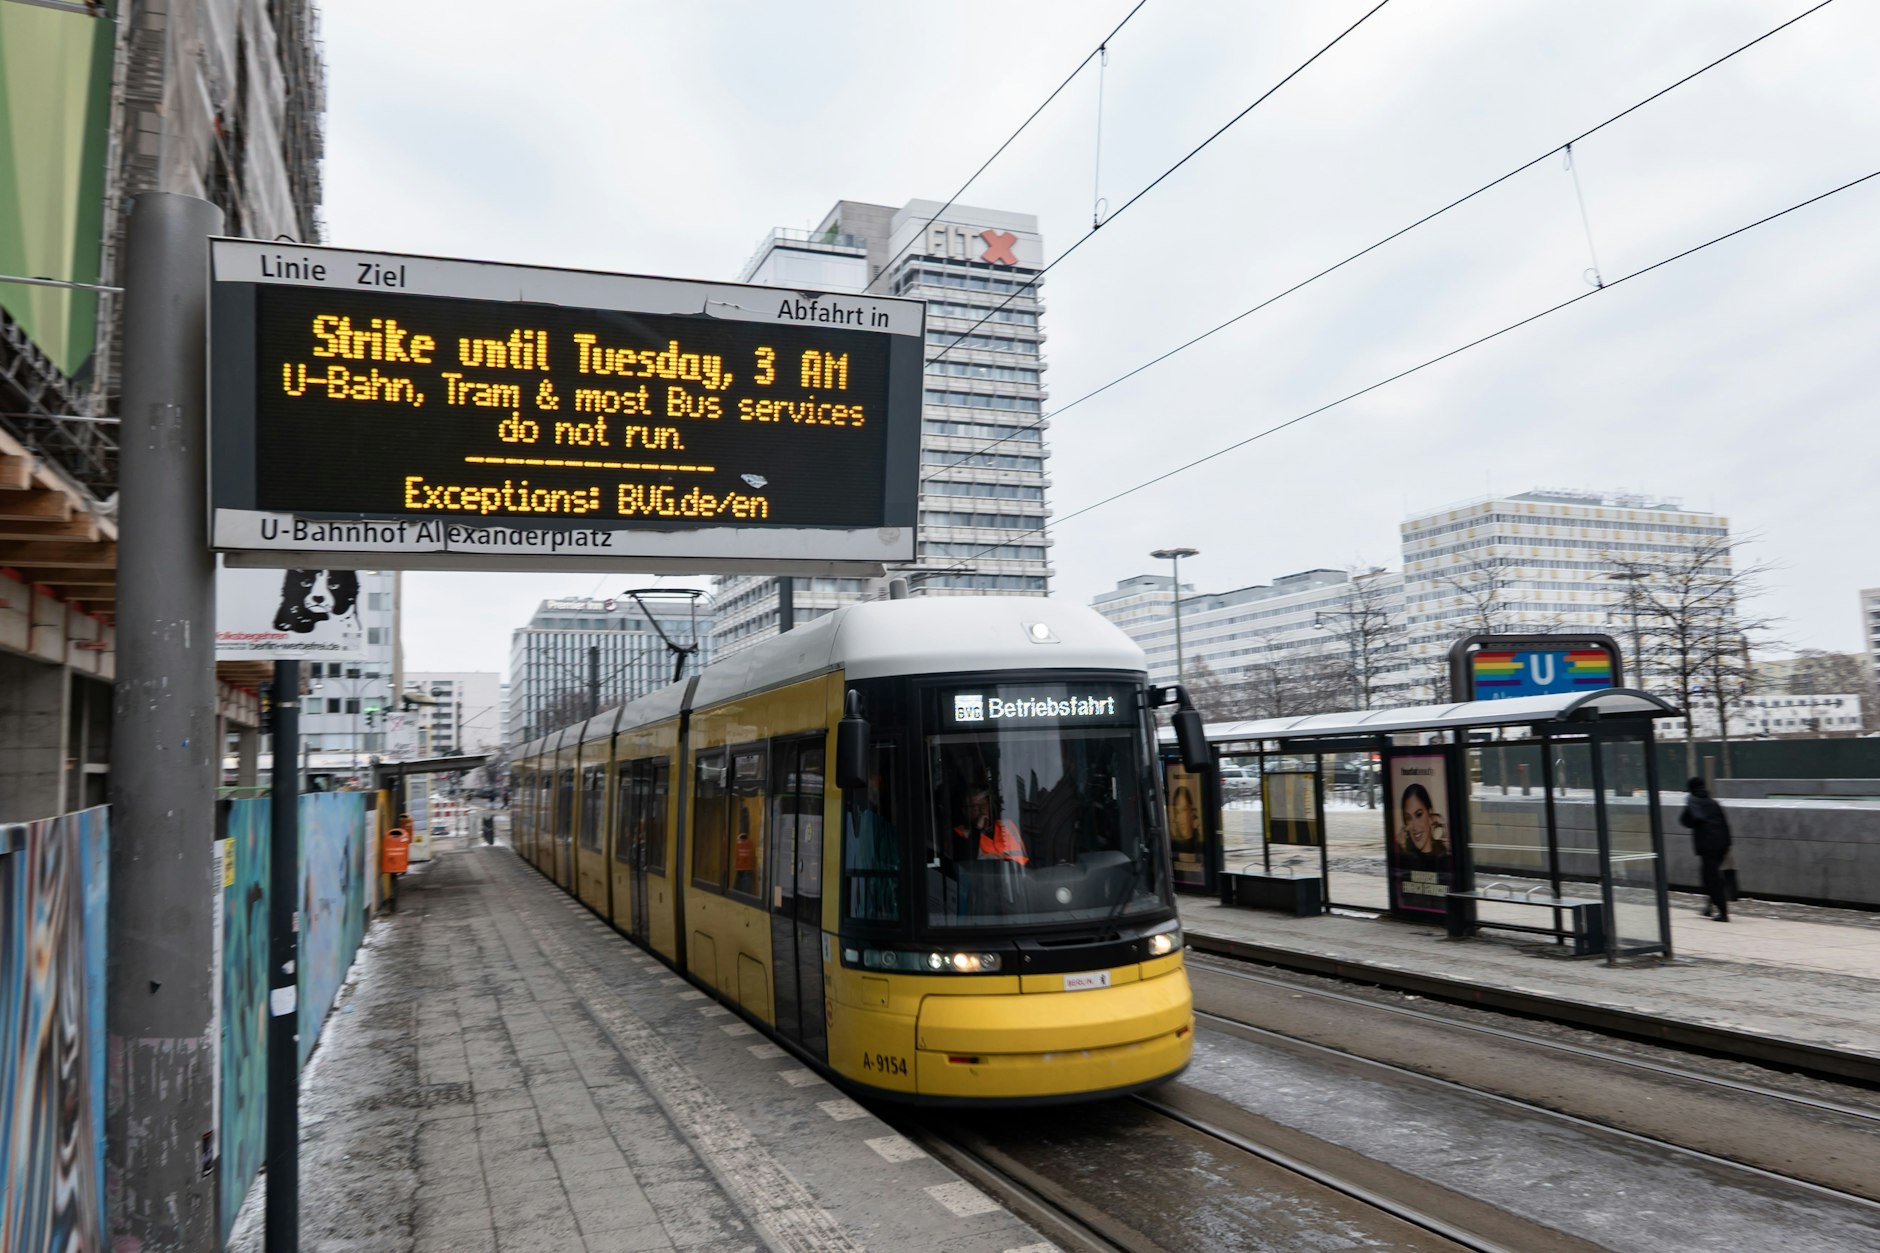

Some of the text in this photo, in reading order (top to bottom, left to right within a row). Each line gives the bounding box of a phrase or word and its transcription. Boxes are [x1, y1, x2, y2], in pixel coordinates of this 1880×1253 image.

[261, 255, 889, 328] Linie Ziel Abfahrt in
[312, 314, 848, 390] Strike until Tuesday, 3 AM
[282, 362, 865, 427] U-Bahn, Tram & most Bus services
[498, 411, 686, 451] do not run.
[404, 476, 769, 519] Exceptions: BVG.de/en
[260, 518, 613, 552] U-Bahnhof Alexanderplatz
[216, 631, 289, 641] olksbegehren
[1529, 653, 1555, 686] U
[988, 696, 1115, 719] Betriebsfahrt
[863, 1051, 908, 1077] A-9154
